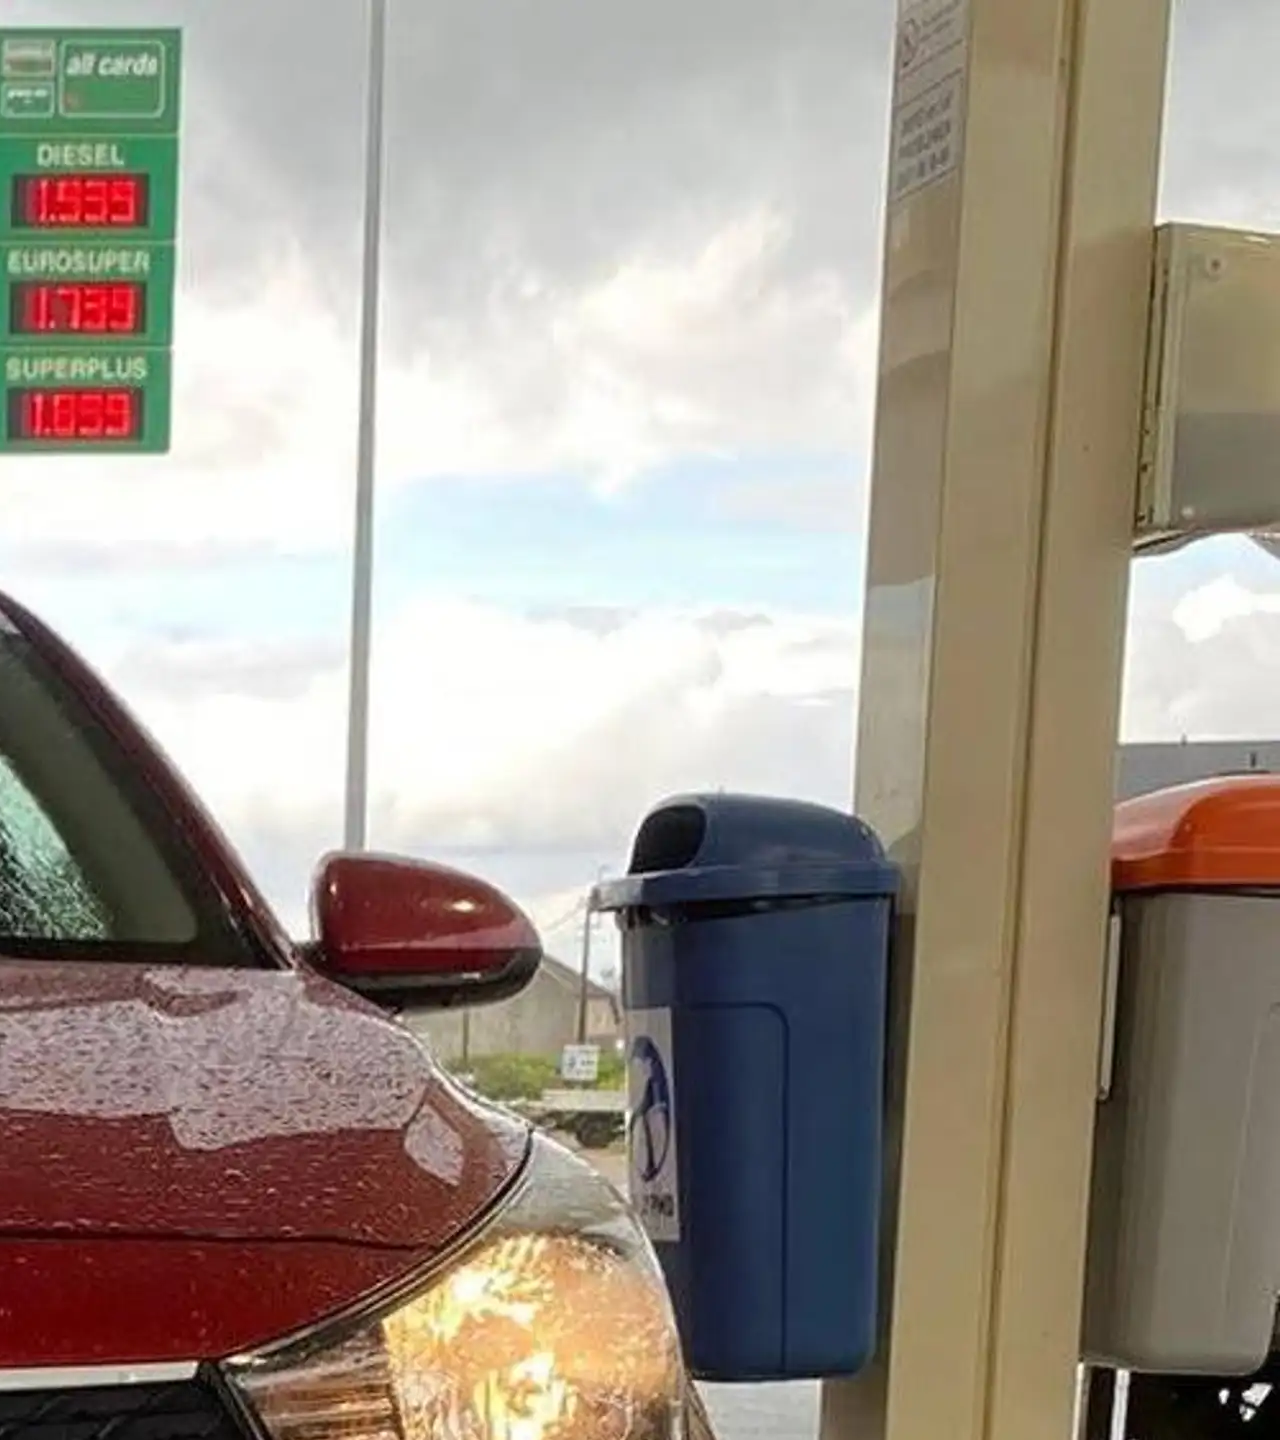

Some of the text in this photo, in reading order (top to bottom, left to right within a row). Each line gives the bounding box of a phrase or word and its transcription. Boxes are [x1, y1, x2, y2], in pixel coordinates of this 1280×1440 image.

[65, 52, 159, 77] all cards
[37, 143, 125, 167] DIESEL
[7, 249, 150, 274] EUROSUPER
[6, 356, 148, 382] SUPERPLUS
